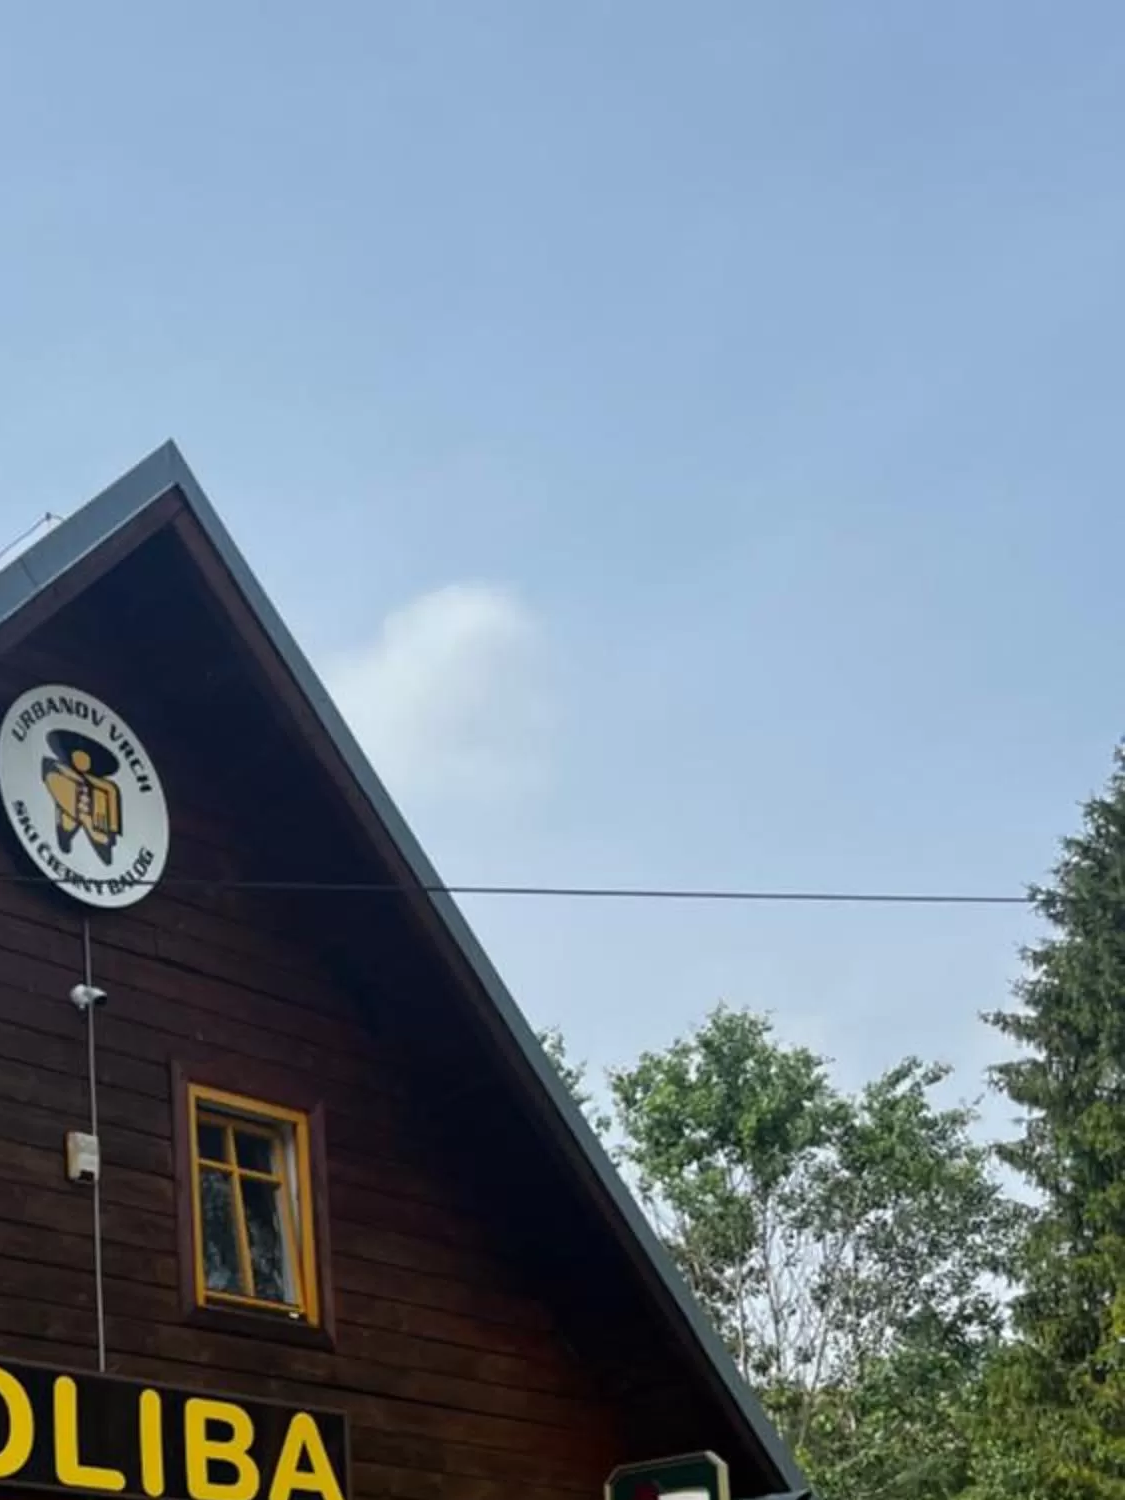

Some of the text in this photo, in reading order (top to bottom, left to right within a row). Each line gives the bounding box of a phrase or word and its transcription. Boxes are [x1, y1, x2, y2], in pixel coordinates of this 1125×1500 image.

[11, 696, 153, 793] URBANOV VRCH
[11, 799, 40, 844] SKI
